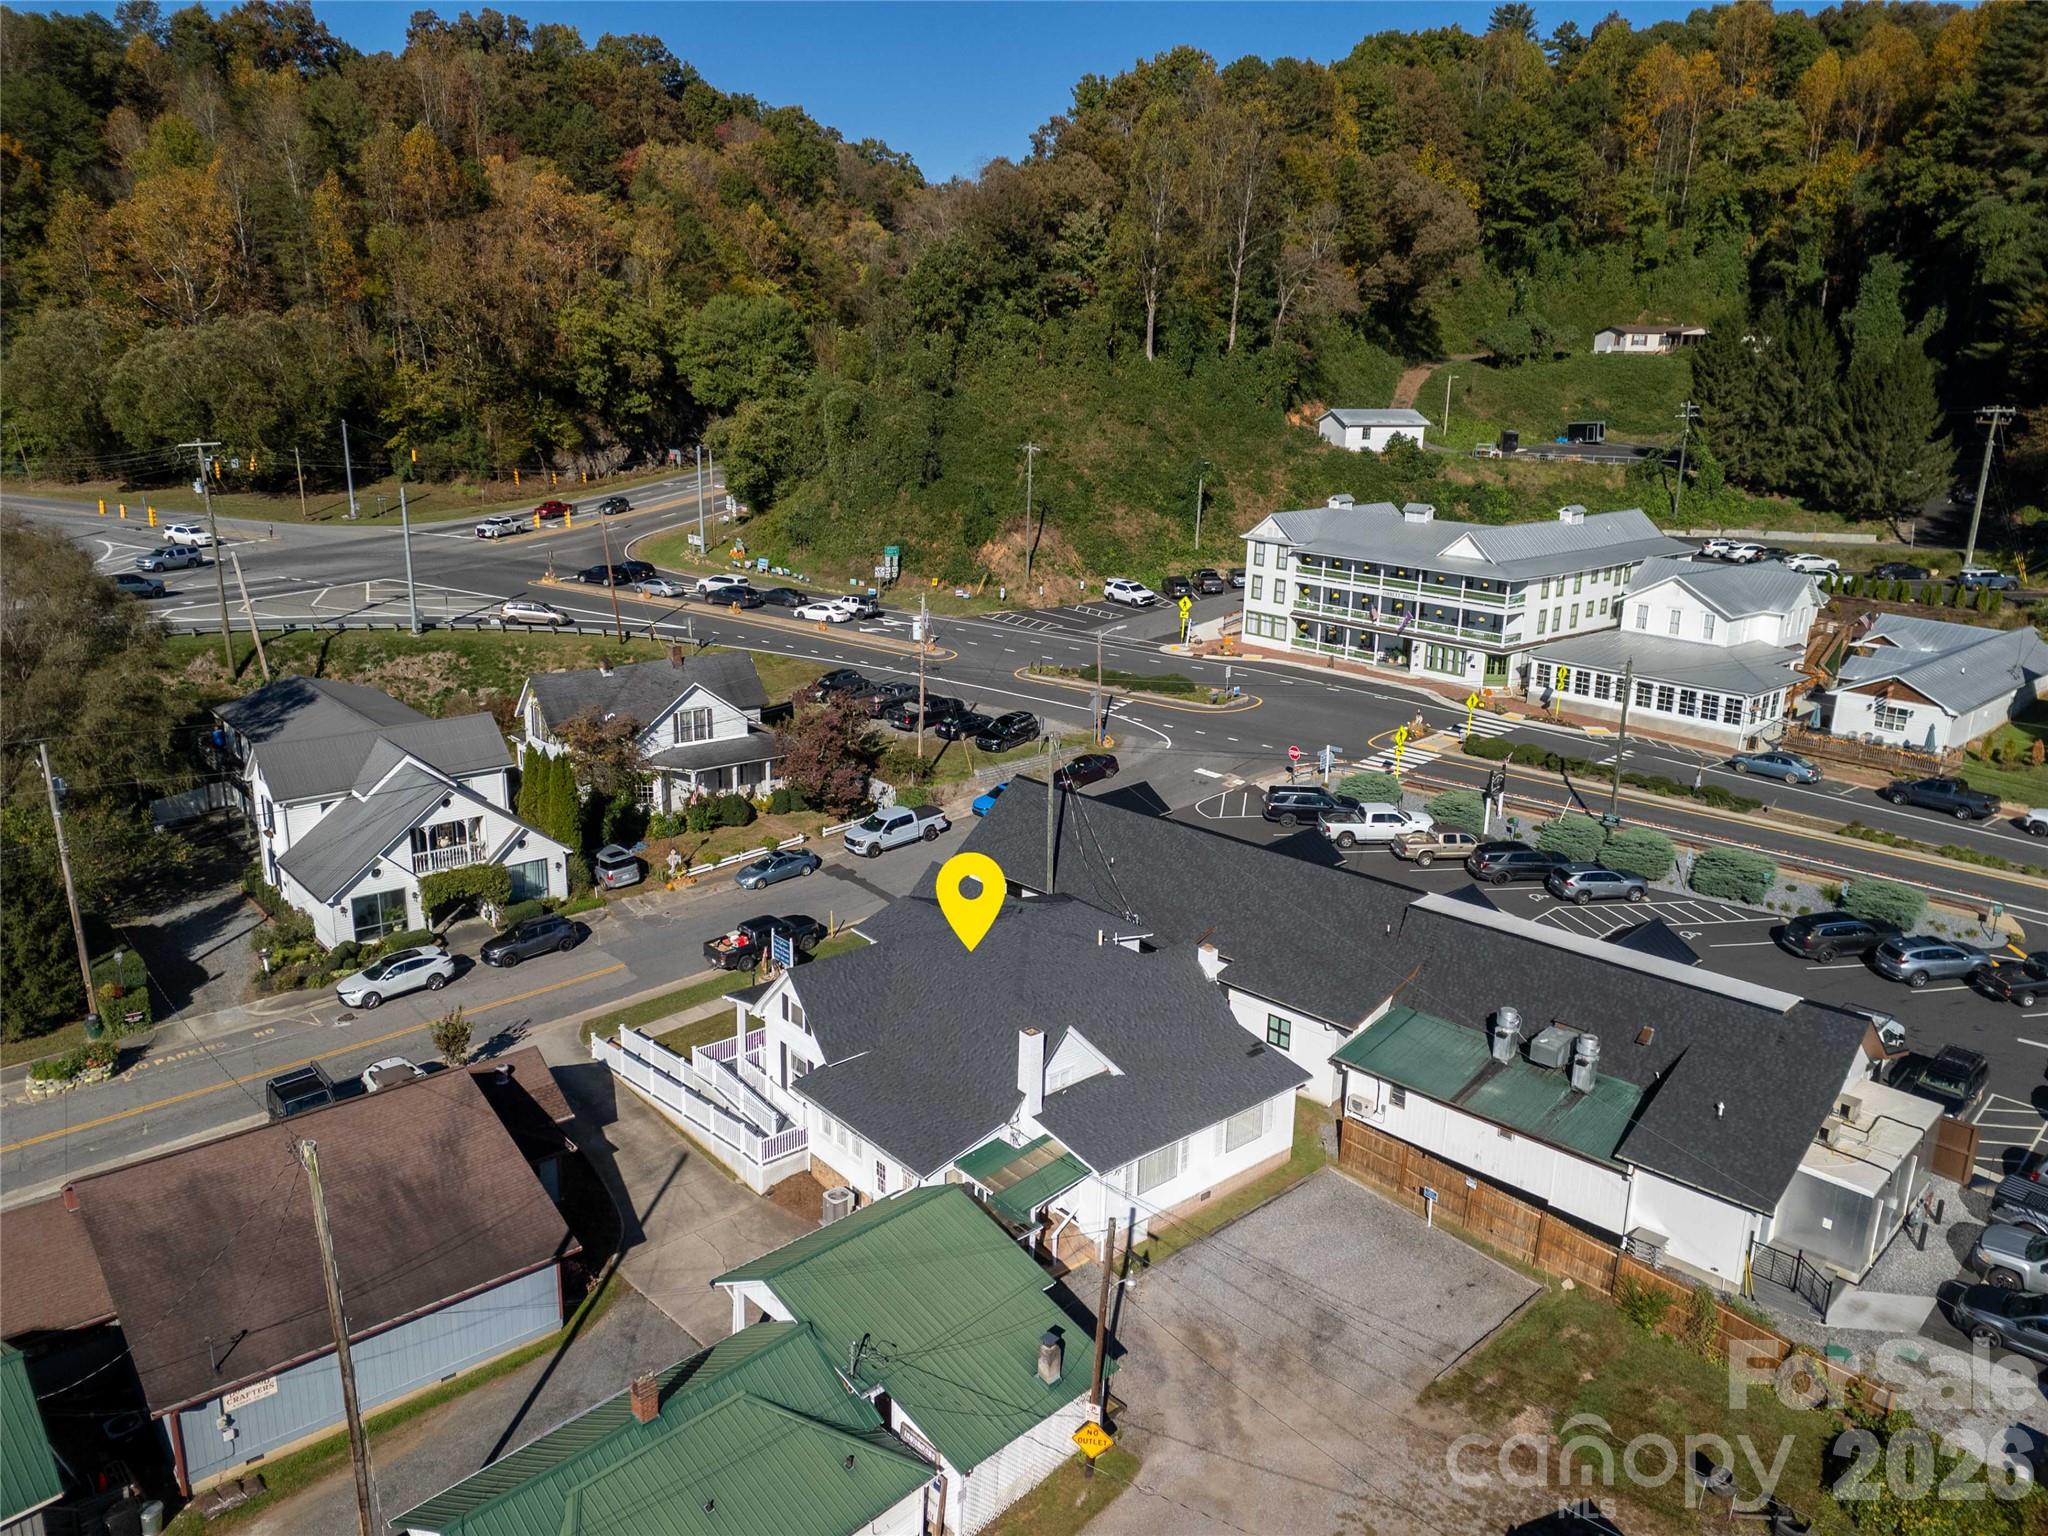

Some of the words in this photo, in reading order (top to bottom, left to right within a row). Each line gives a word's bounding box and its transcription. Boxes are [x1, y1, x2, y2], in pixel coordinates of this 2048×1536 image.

[253, 1027, 276, 1039] NO
[154, 1041, 227, 1066] PARKING
[226, 1381, 275, 1406] CRAFTERS
[1086, 1429, 1099, 1437] NO
[1077, 1437, 1107, 1446] OUTLET
